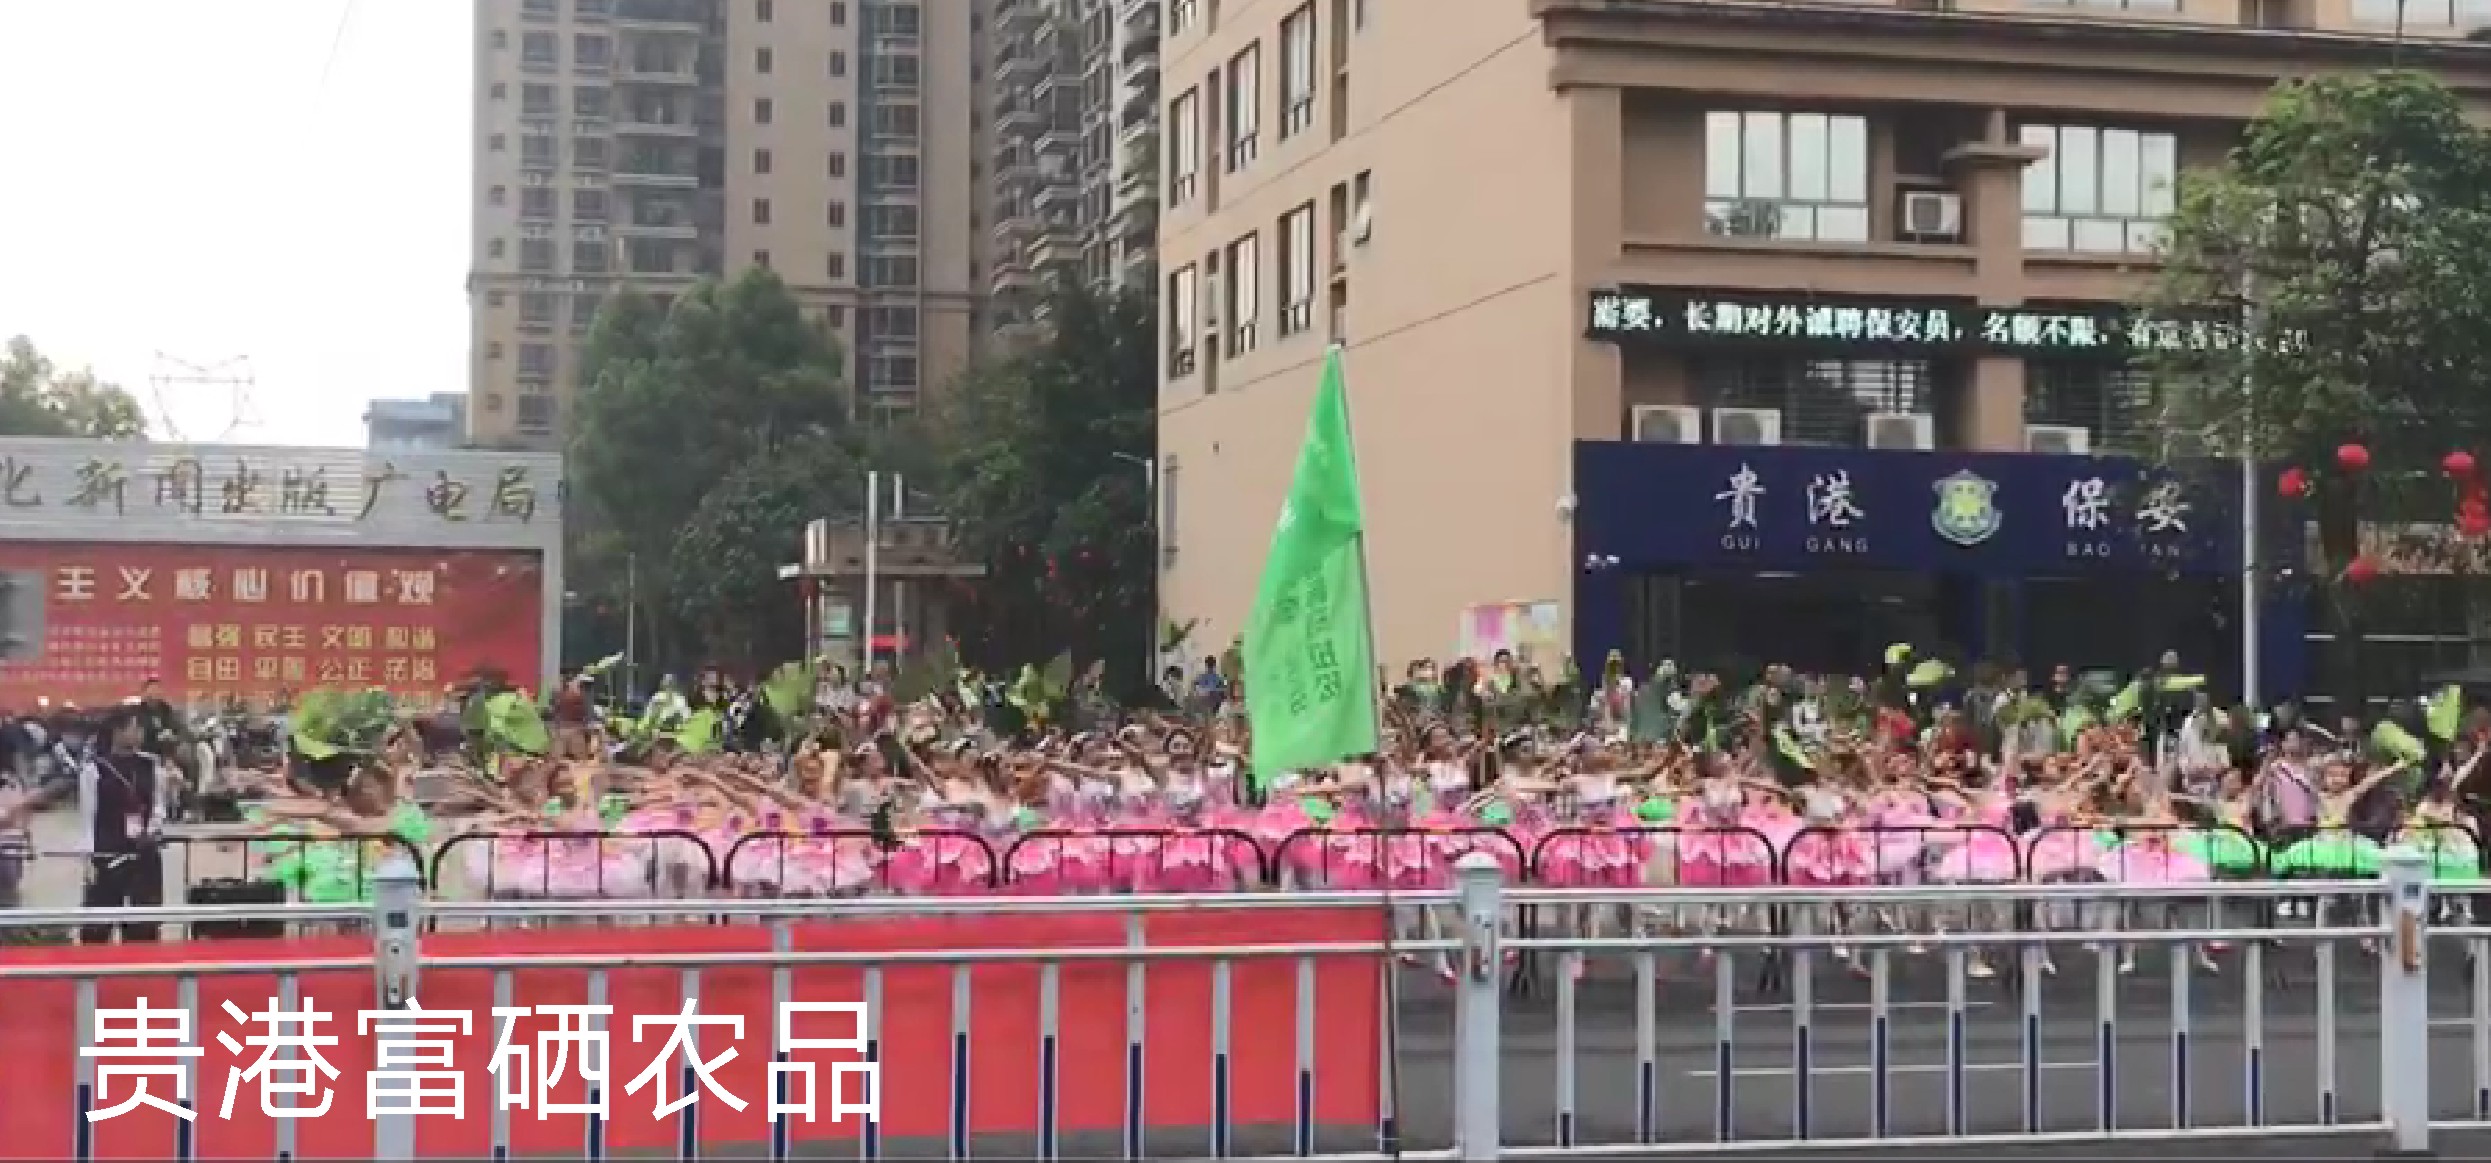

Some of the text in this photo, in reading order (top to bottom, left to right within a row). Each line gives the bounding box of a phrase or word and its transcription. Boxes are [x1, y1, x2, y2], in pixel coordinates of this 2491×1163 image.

[2063, 477, 2190, 532] 保安
[1720, 534, 1761, 550] GUI
[1806, 536, 1869, 552] GANG
[254, 624, 306, 648] 民主
